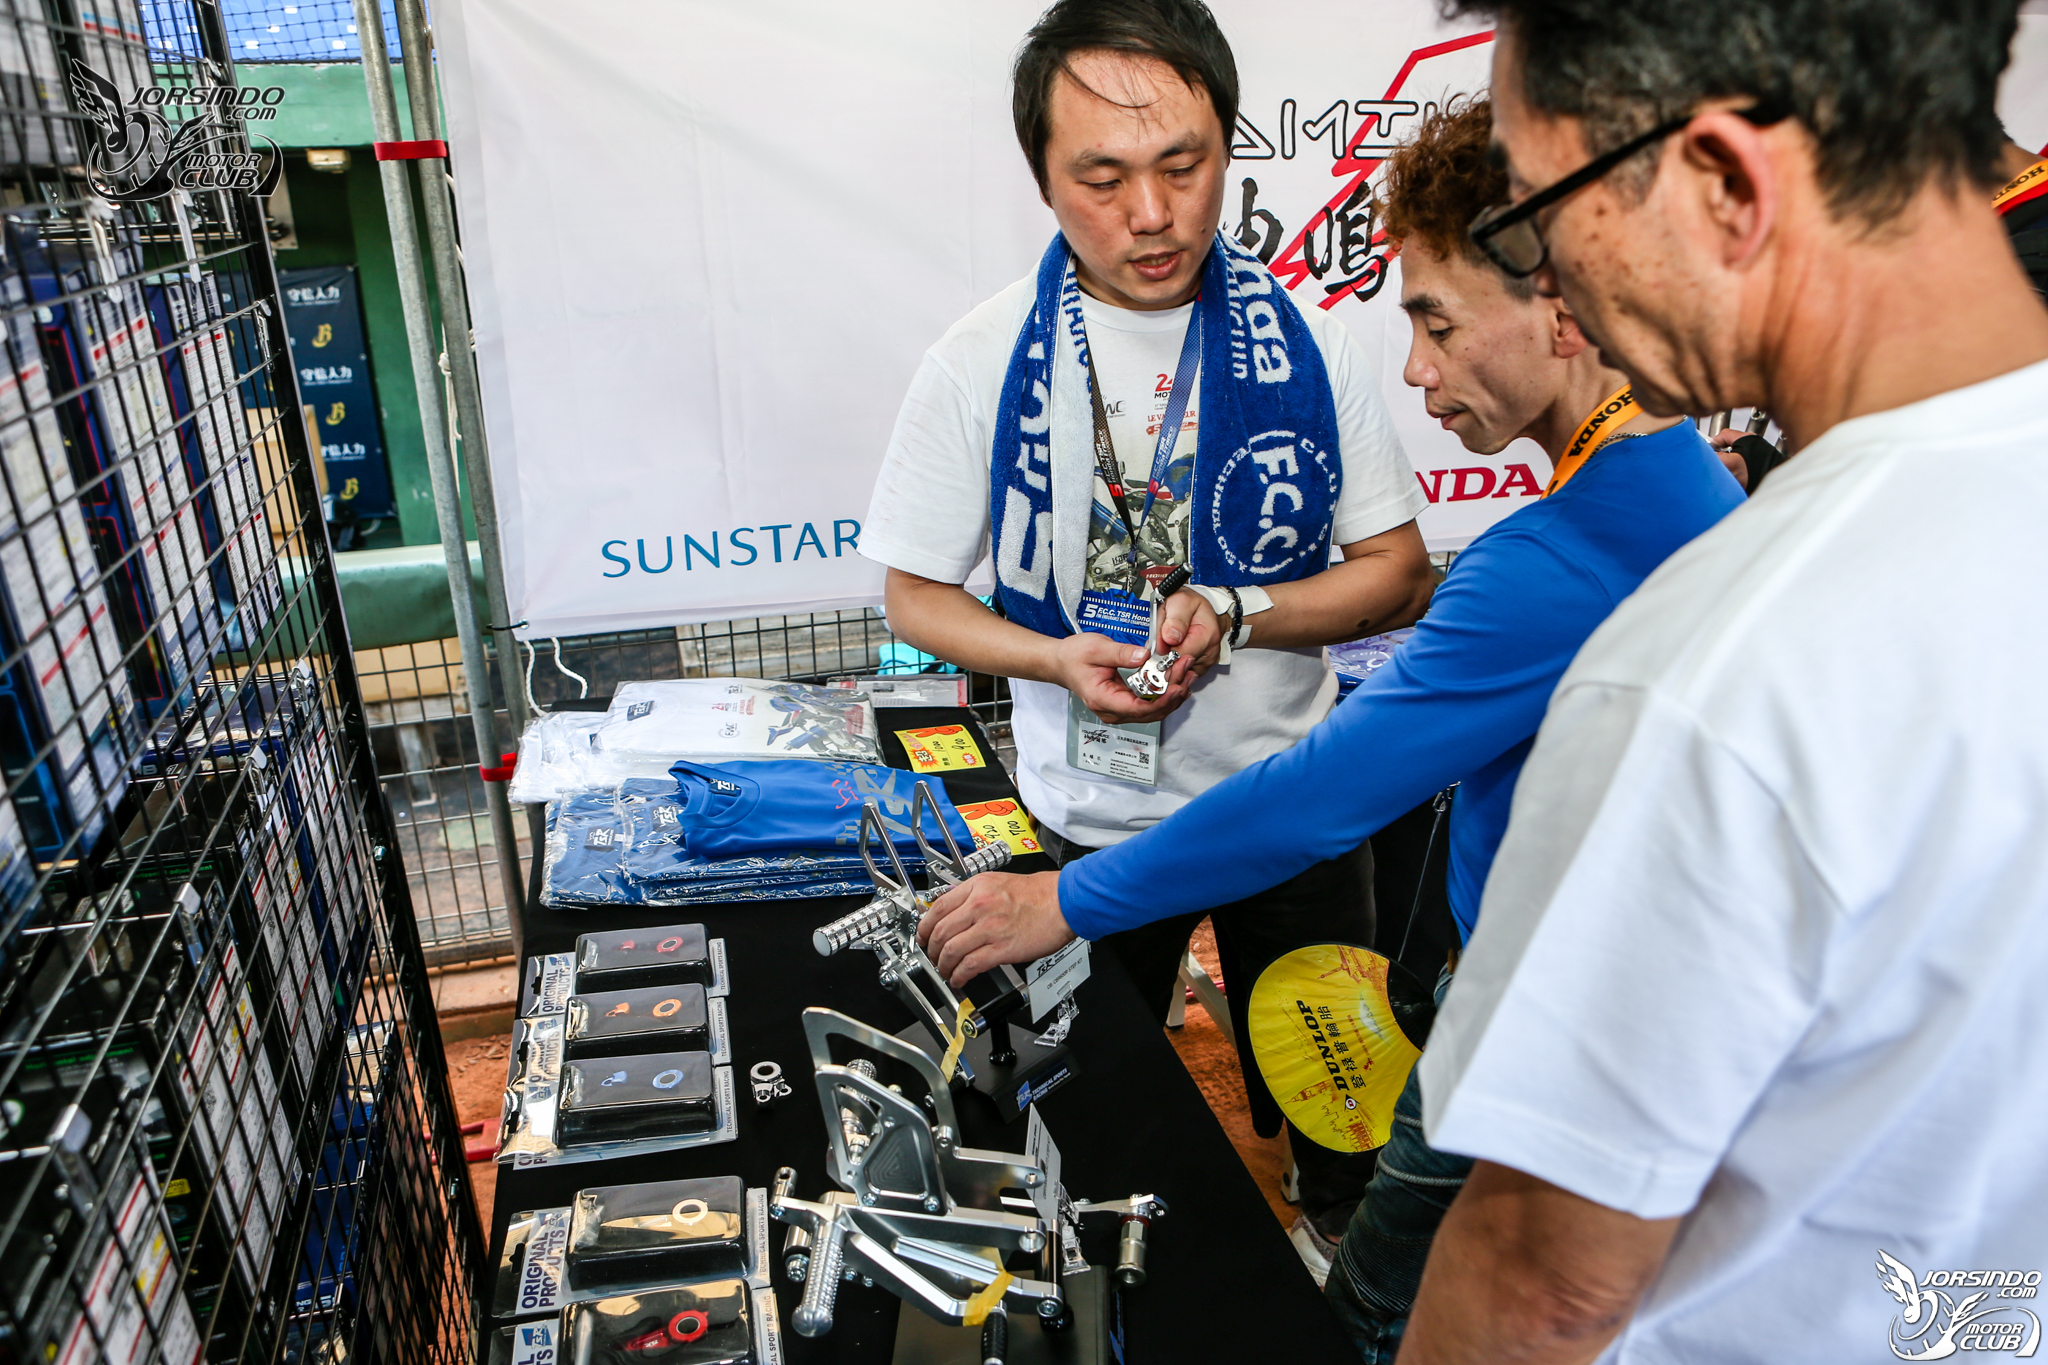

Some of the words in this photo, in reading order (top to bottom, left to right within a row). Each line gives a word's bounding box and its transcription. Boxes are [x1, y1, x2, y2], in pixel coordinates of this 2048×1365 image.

[1567, 389, 1635, 459] HONDA
[1415, 463, 1545, 504] NDA
[601, 518, 862, 578] SUNSTAR
[1083, 603, 1098, 618] 5
[1117, 610, 1131, 619] TSR
[1132, 614, 1150, 622] Hond
[1007, 820, 1026, 836] 700
[542, 969, 559, 1012] ORIGINAL
[1296, 1000, 1349, 1091] DUNLOP
[724, 1088, 732, 1106] SPORTS
[725, 1106, 733, 1133] TECHNICAL
[758, 1215, 766, 1241] SPORTS
[521, 1232, 549, 1309] ORIGINAL
[538, 1229, 566, 1308] PRODUCTS
[759, 1241, 767, 1276] TECHNICAL
[764, 1295, 773, 1322] RACING
[766, 1322, 777, 1351] SPORTS
